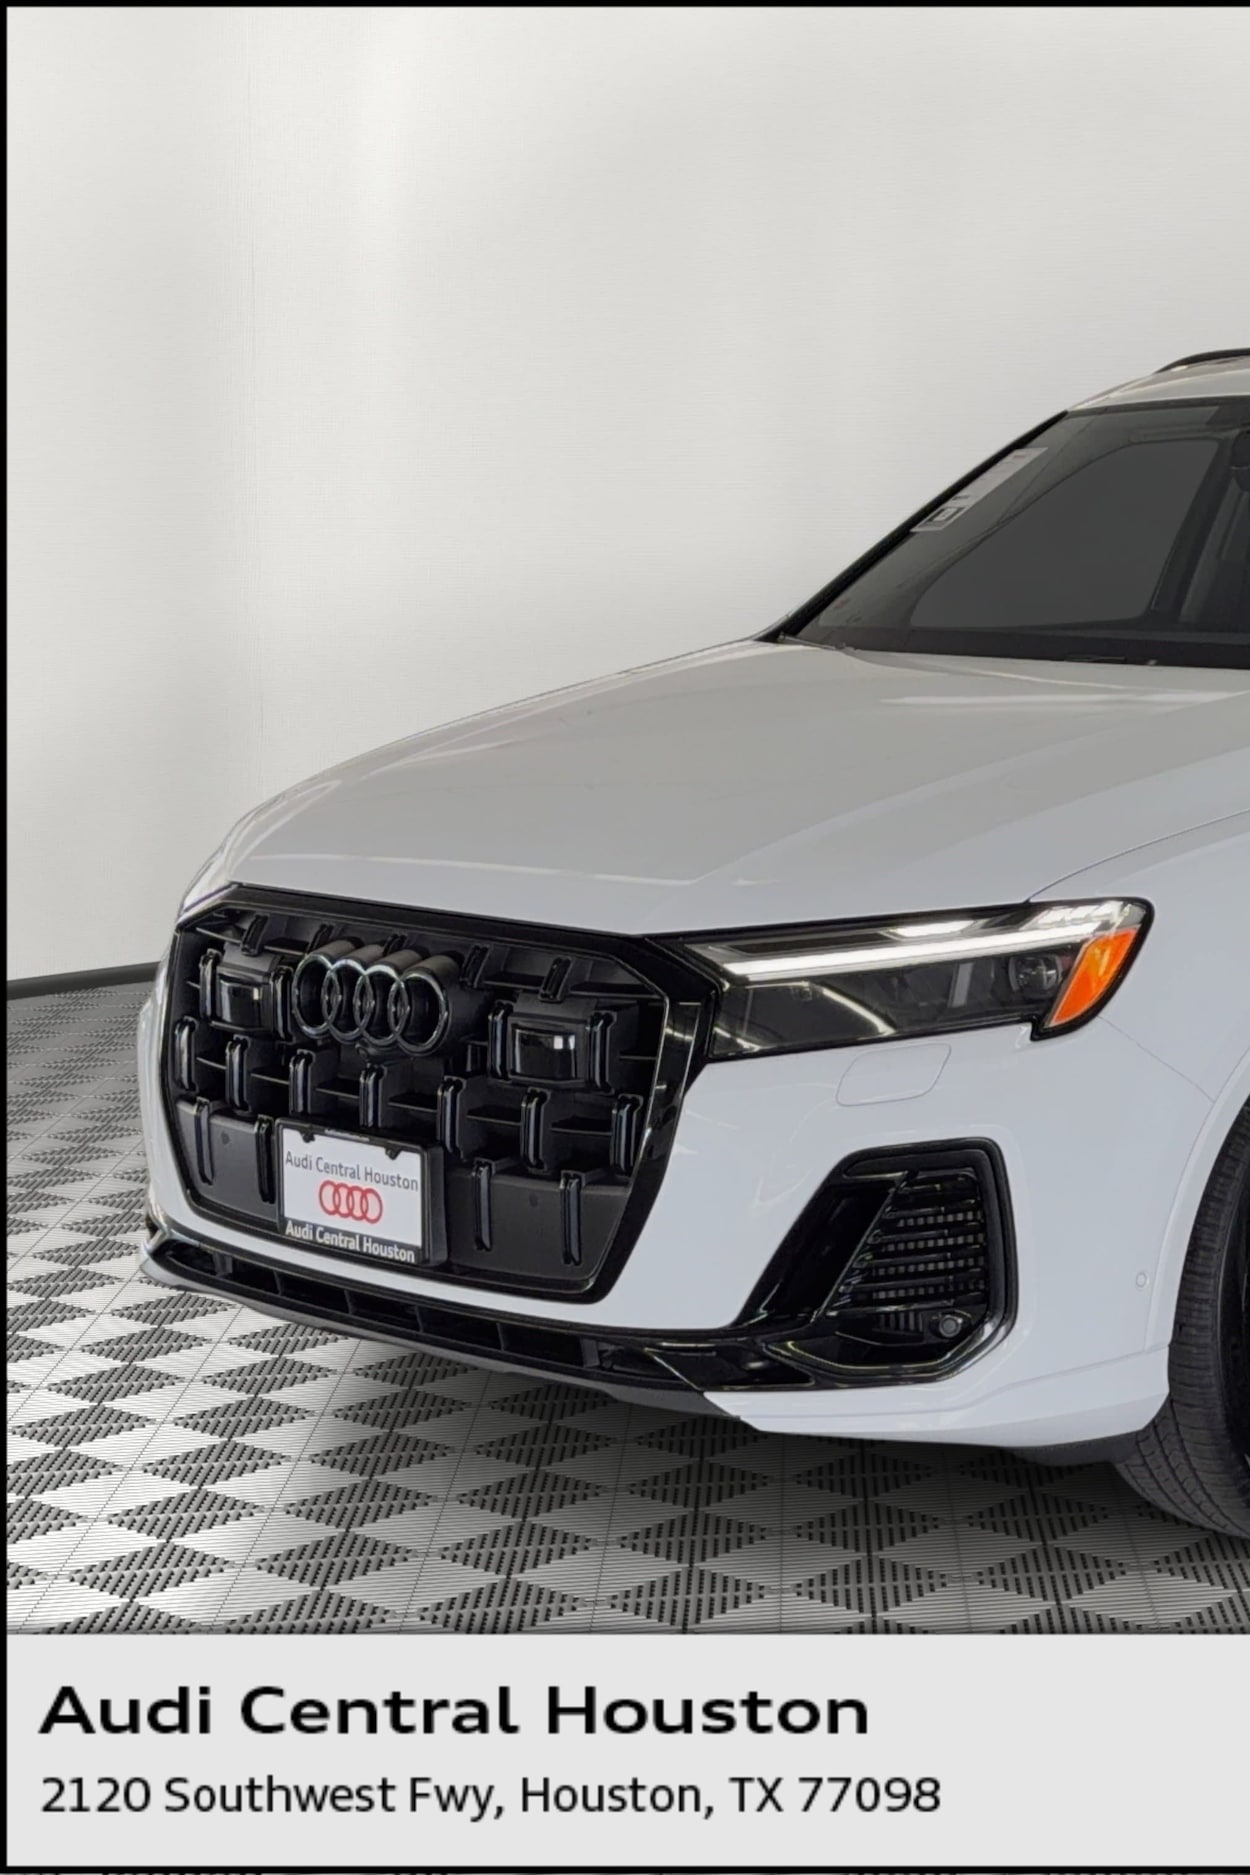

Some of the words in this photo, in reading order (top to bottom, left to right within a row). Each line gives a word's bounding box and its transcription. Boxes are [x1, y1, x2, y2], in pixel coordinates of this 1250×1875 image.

[285, 1151, 312, 1171] Audi
[316, 1157, 360, 1180] Central
[364, 1166, 418, 1191] Houston
[285, 1219, 313, 1241] Audi
[316, 1226, 360, 1251] Central
[363, 1237, 415, 1263] Houston
